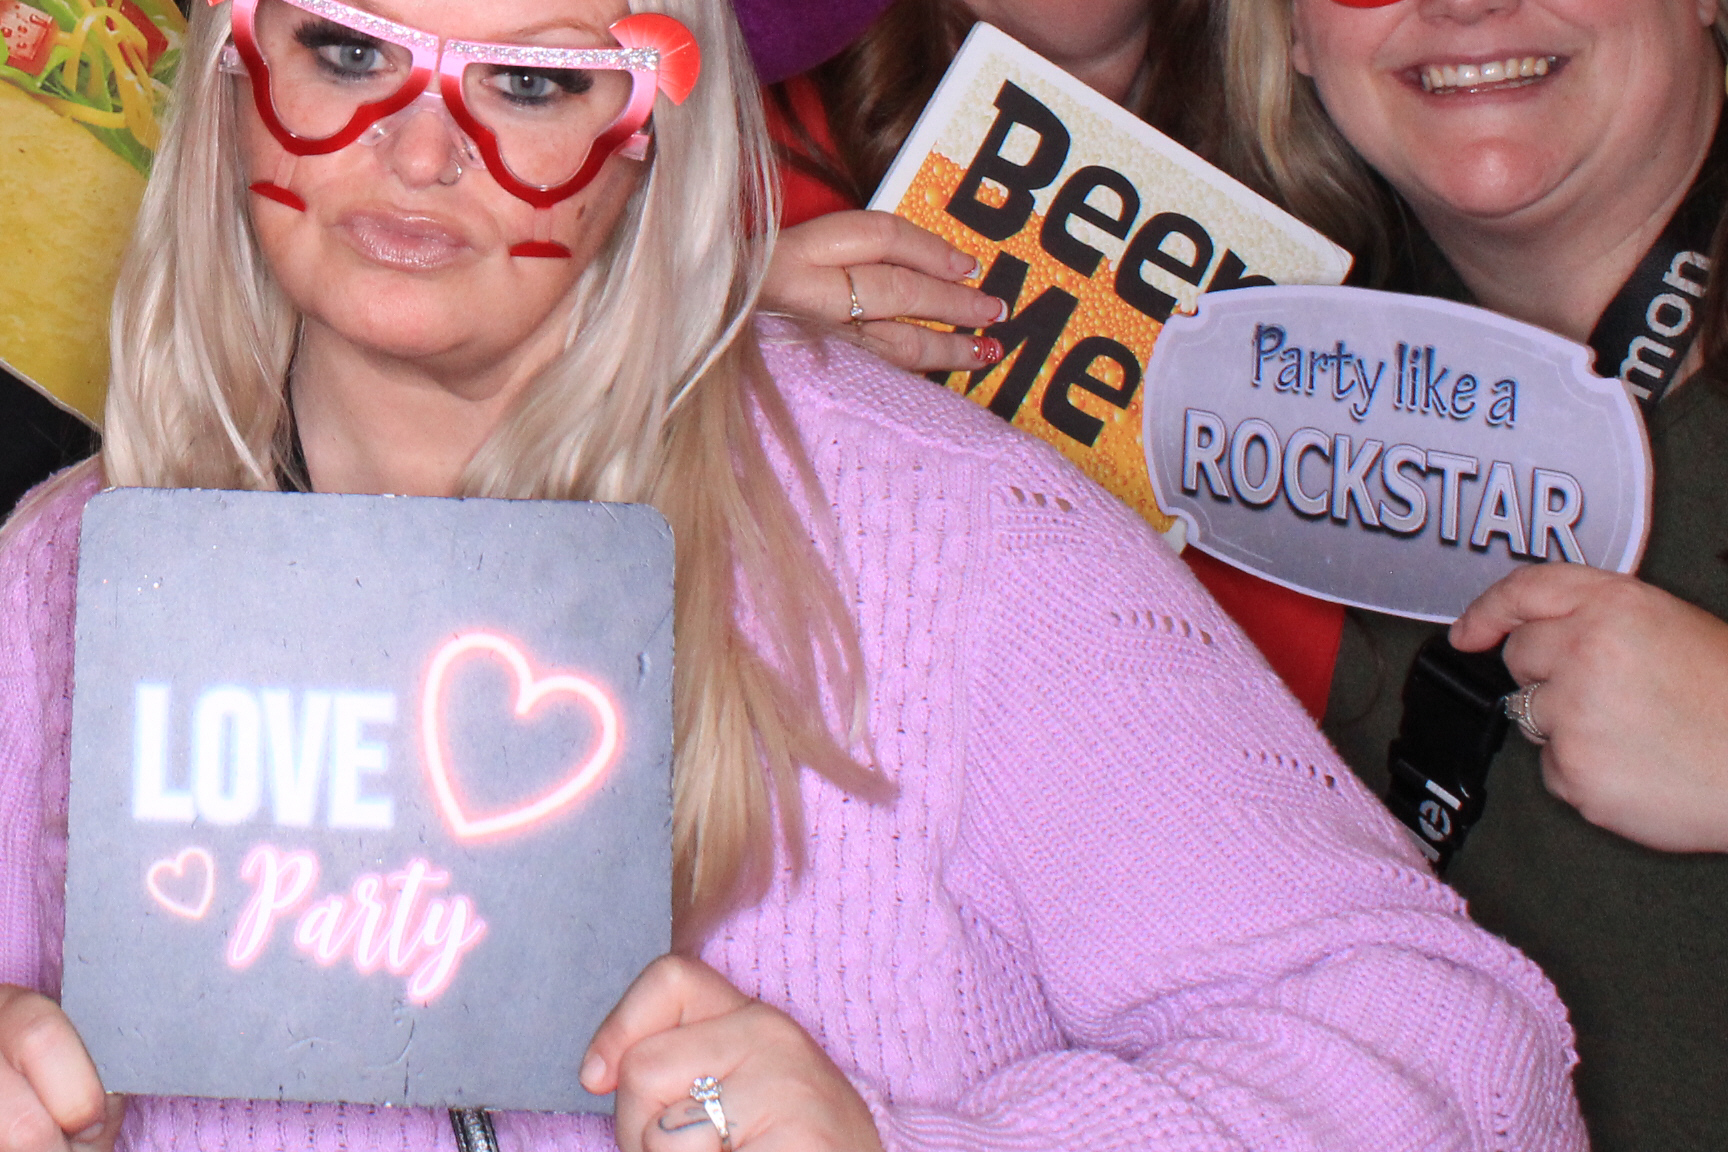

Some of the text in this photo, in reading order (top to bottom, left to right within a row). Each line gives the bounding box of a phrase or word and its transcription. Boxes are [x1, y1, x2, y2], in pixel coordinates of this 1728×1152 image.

[924, 250, 1142, 448] Me
[1251, 322, 1518, 427] Party like a
[1182, 408, 1587, 565] ROCKSTAR
[132, 682, 396, 829] LOVE
[226, 845, 487, 1003] Party
